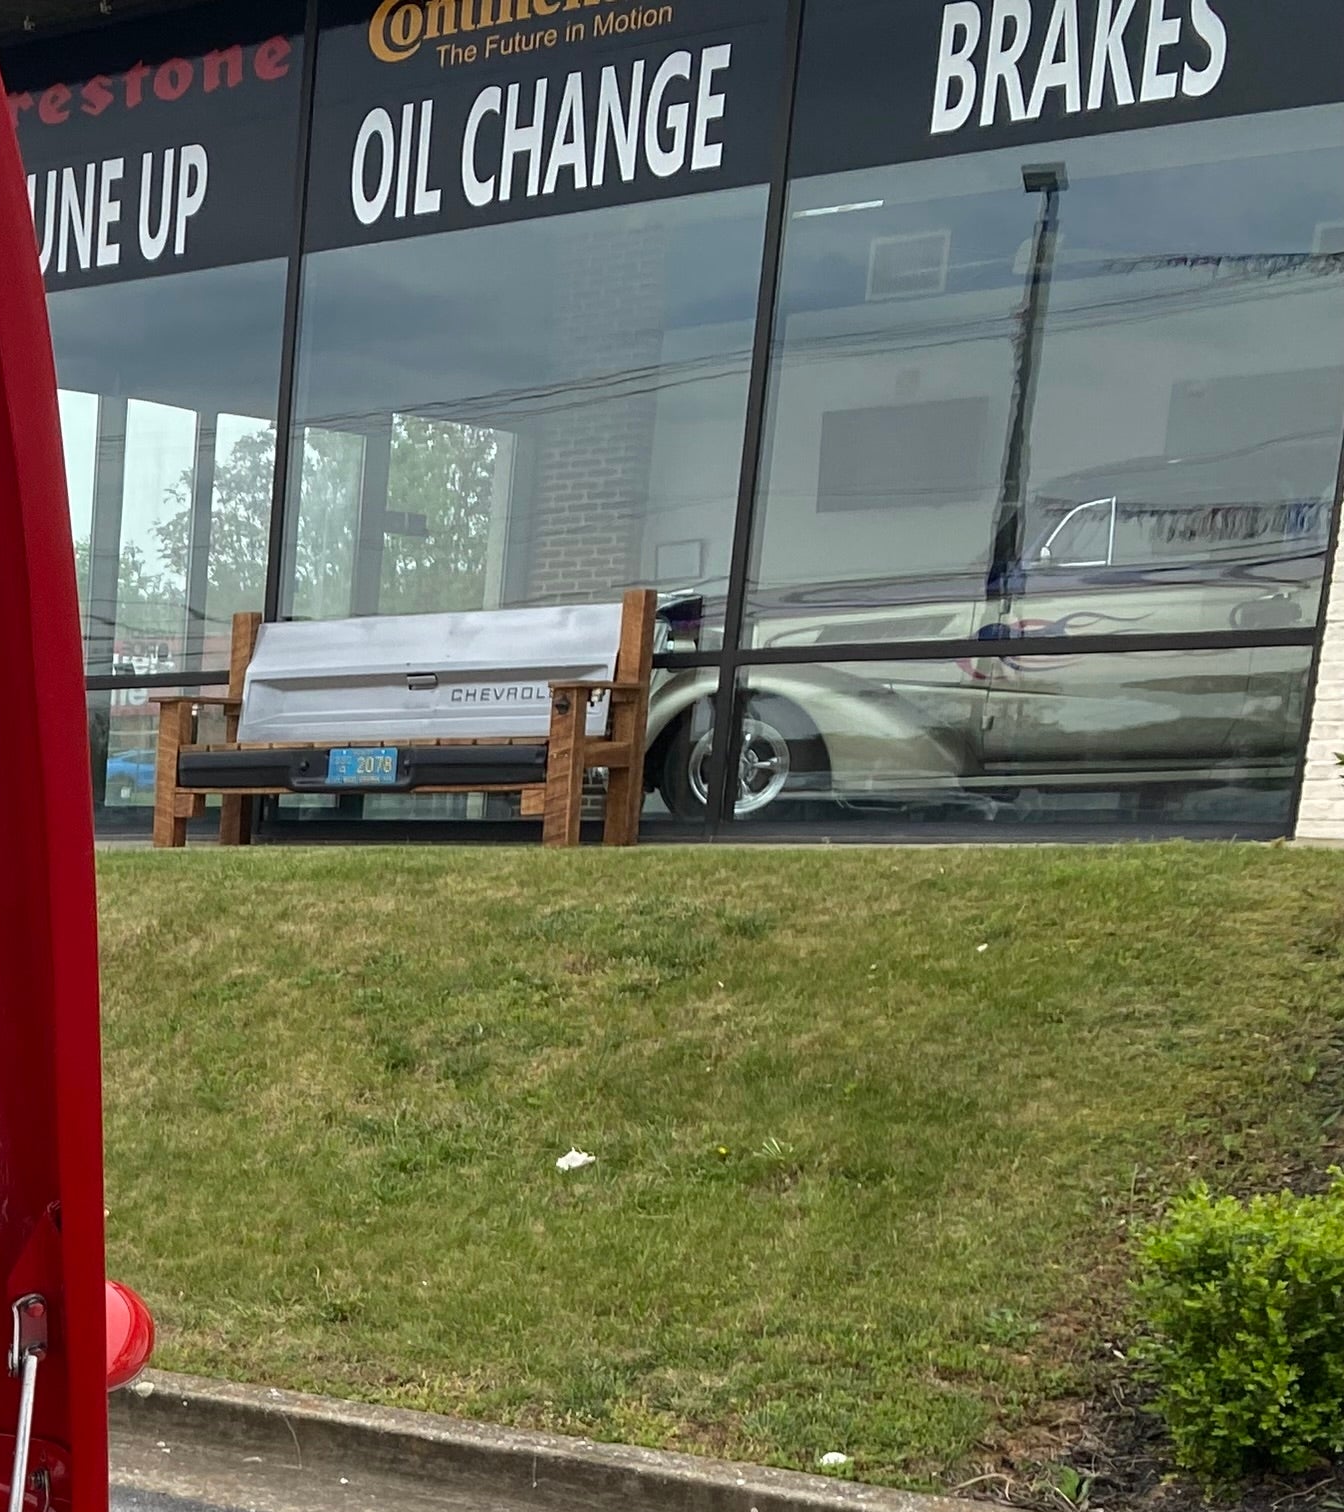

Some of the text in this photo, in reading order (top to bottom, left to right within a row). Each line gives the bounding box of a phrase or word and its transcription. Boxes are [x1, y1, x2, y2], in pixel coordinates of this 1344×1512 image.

[7, 34, 292, 129] restone
[436, 5, 672, 69] The Future in Motion
[930, 0, 1227, 134] BRAKES
[351, 43, 731, 225] OIL CHANGE
[27, 143, 208, 277] UNE UP
[451, 686, 553, 702] CHEVROL
